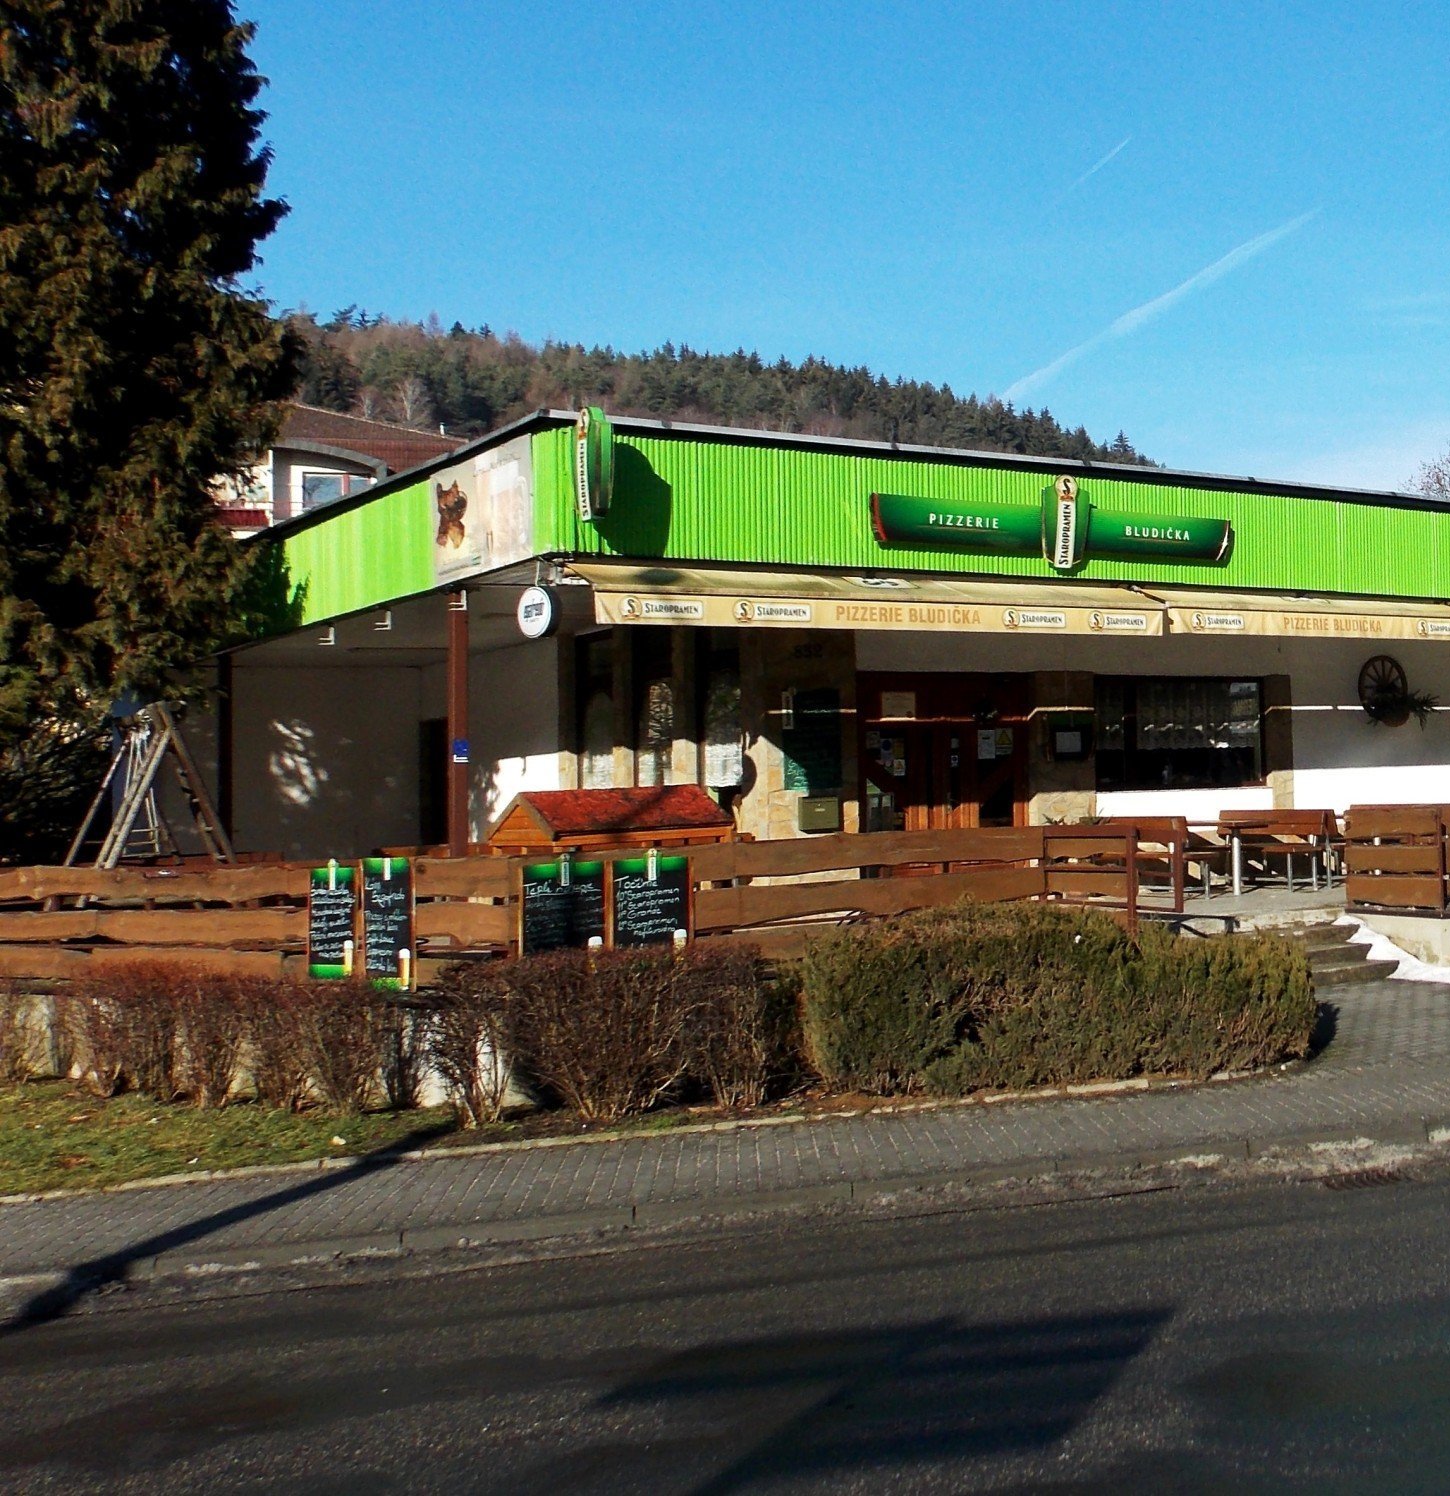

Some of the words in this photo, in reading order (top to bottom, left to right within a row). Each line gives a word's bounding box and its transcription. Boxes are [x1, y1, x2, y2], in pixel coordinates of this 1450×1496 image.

[929, 513, 1000, 530] PIZZERIE
[1058, 503, 1073, 566] STAROPRAMEN
[1125, 525, 1191, 542] BLUDIČKA
[645, 601, 699, 615] STAROPRAMEN
[757, 605, 807, 617] STAROPRAMEN
[836, 605, 903, 622] PIZZERIE
[909, 604, 981, 625] BLUDIČKA
[1021, 613, 1063, 625] STAROPRAMEN
[1106, 615, 1144, 628] STAROPRAMEN
[1284, 616, 1330, 631] PIZZERIE
[1333, 616, 1382, 632] BLUDIČKA
